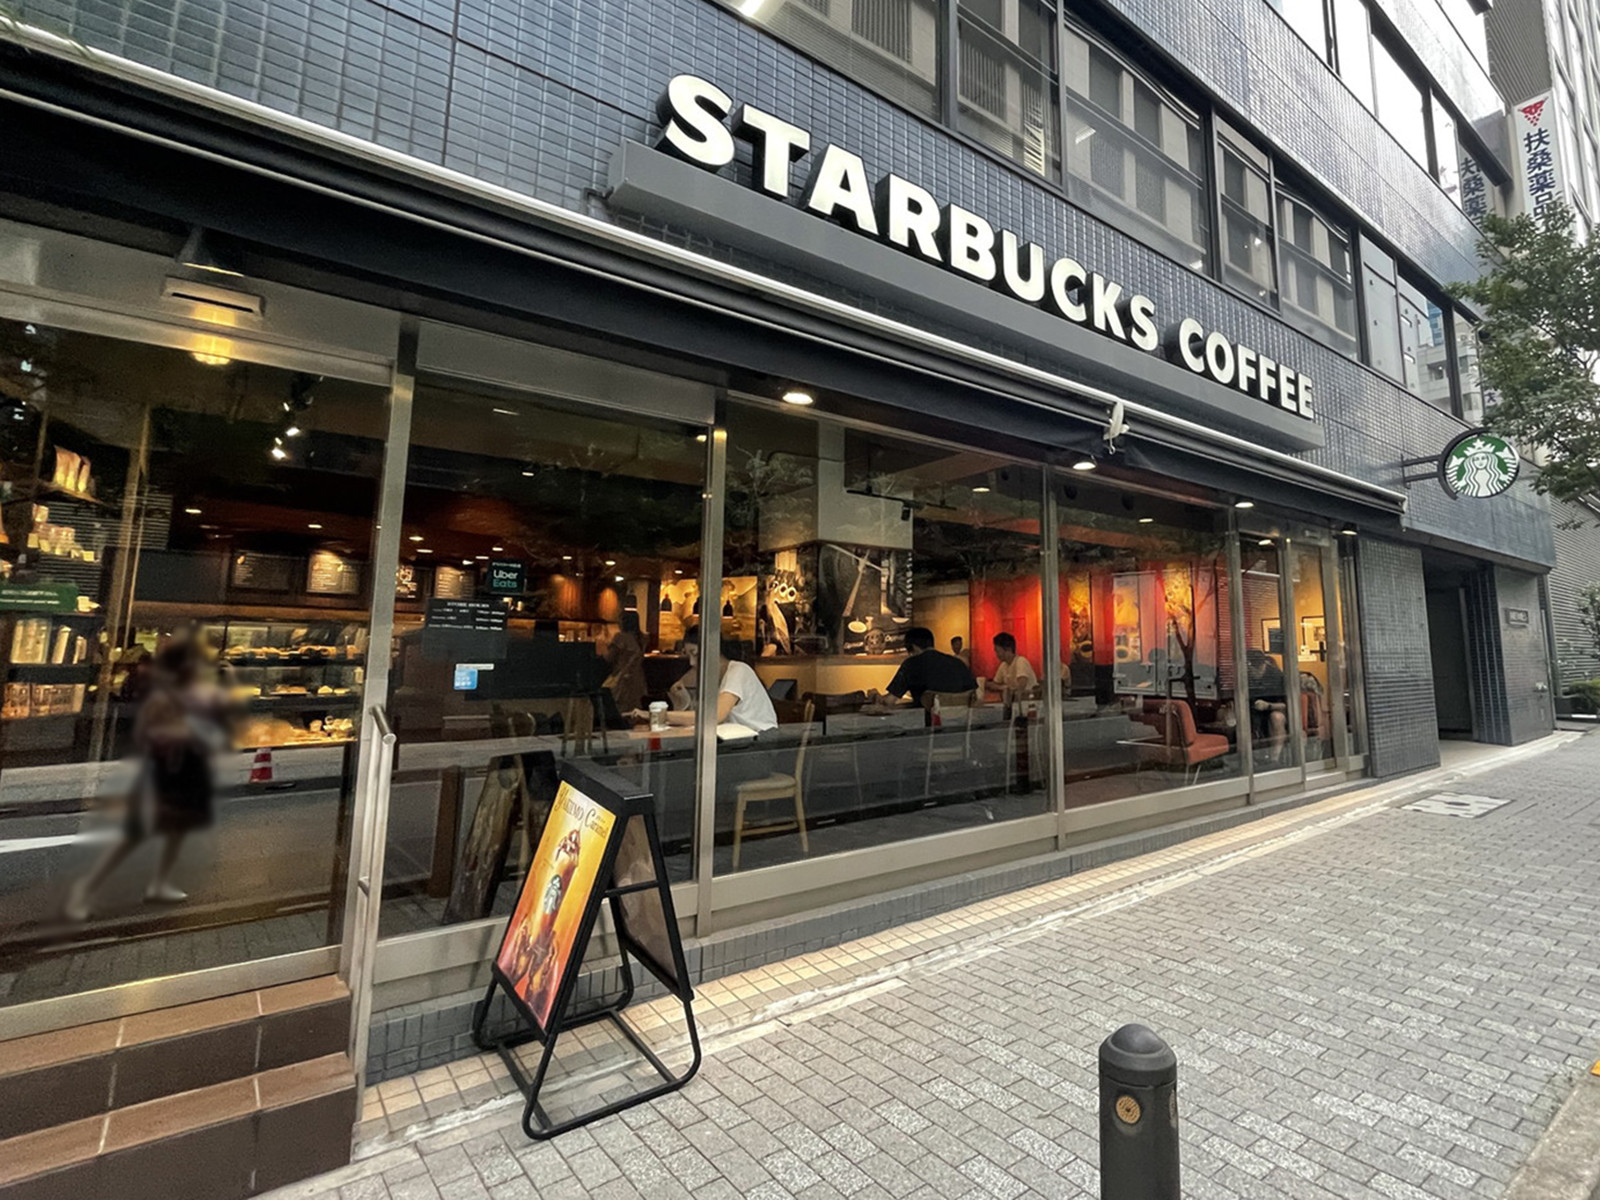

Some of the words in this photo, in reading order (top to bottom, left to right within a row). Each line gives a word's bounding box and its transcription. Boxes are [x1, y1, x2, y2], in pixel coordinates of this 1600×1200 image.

[664, 74, 1158, 351] STARBUCKS
[1178, 317, 1314, 420] COFFEE
[493, 569, 518, 579] Uber
[493, 579, 517, 588] Eats
